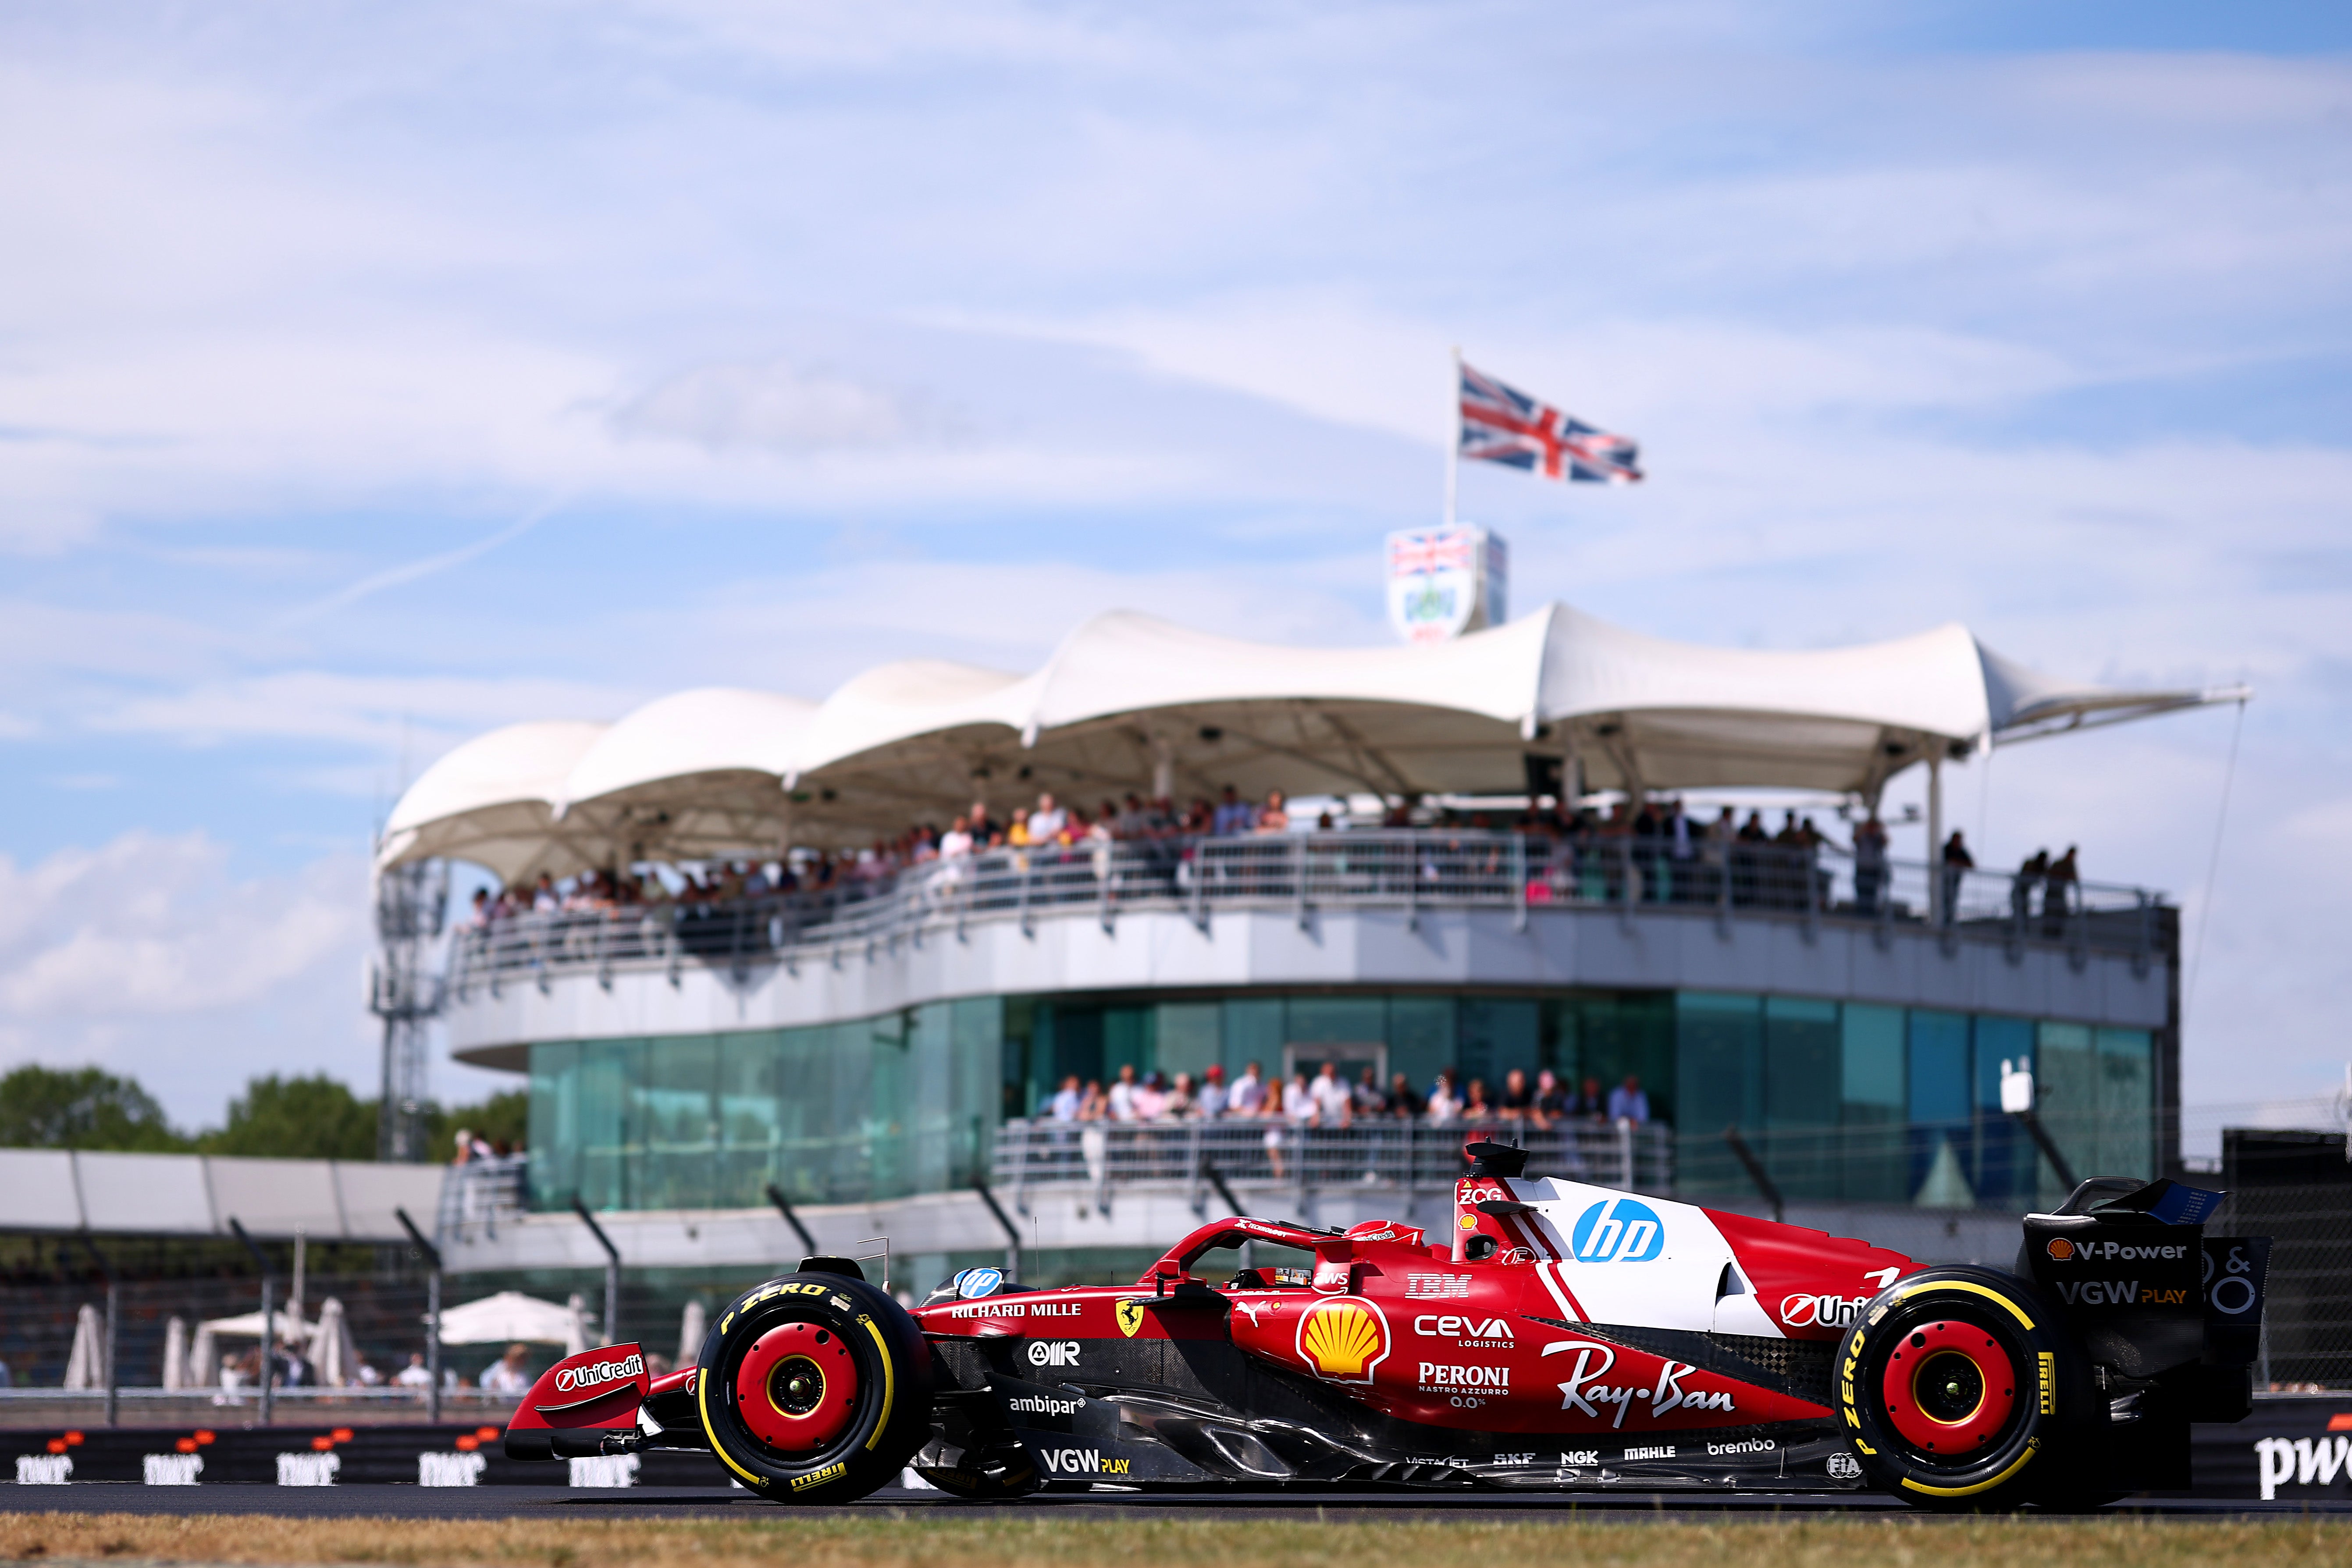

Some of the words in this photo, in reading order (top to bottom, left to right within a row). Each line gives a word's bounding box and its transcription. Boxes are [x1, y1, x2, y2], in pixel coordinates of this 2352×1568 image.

[1459, 1188, 1502, 1205] ZCG
[1248, 1223, 1287, 1237] TECHNOLOGY
[1579, 1199, 1658, 1261] hp
[2075, 1242, 2187, 1260] V-Power
[961, 1269, 994, 1298] hp
[1313, 1272, 1348, 1285] aws
[1405, 1273, 1473, 1298] IBM
[2056, 1281, 2139, 1304] VGW
[2142, 1289, 2187, 1304] PLAY
[721, 1311, 735, 1335] P
[740, 1283, 828, 1313] ZERO
[952, 1305, 1025, 1318] RICHARD
[1031, 1303, 1081, 1316] MILLE
[1459, 1340, 1514, 1348] LOGISTICS
[576, 1355, 642, 1386] UniCredit
[1419, 1362, 1509, 1386] PERONI
[1842, 1330, 1865, 1429] ZERO
[2038, 1352, 2055, 1415] PIRELLI
[1010, 1395, 1076, 1416] ambipar
[1624, 1446, 1675, 1460] MAHLE
[1707, 1438, 1775, 1455] brembo
[1856, 1438, 1877, 1454] P
[1040, 1449, 1099, 1472] VGW
[1100, 1459, 1130, 1474] PLAY
[1493, 1453, 1536, 1465] SKF
[1561, 1451, 1599, 1465] NGK
[2253, 1435, 2352, 1500] pw
[791, 1462, 847, 1492] PIRELLI
